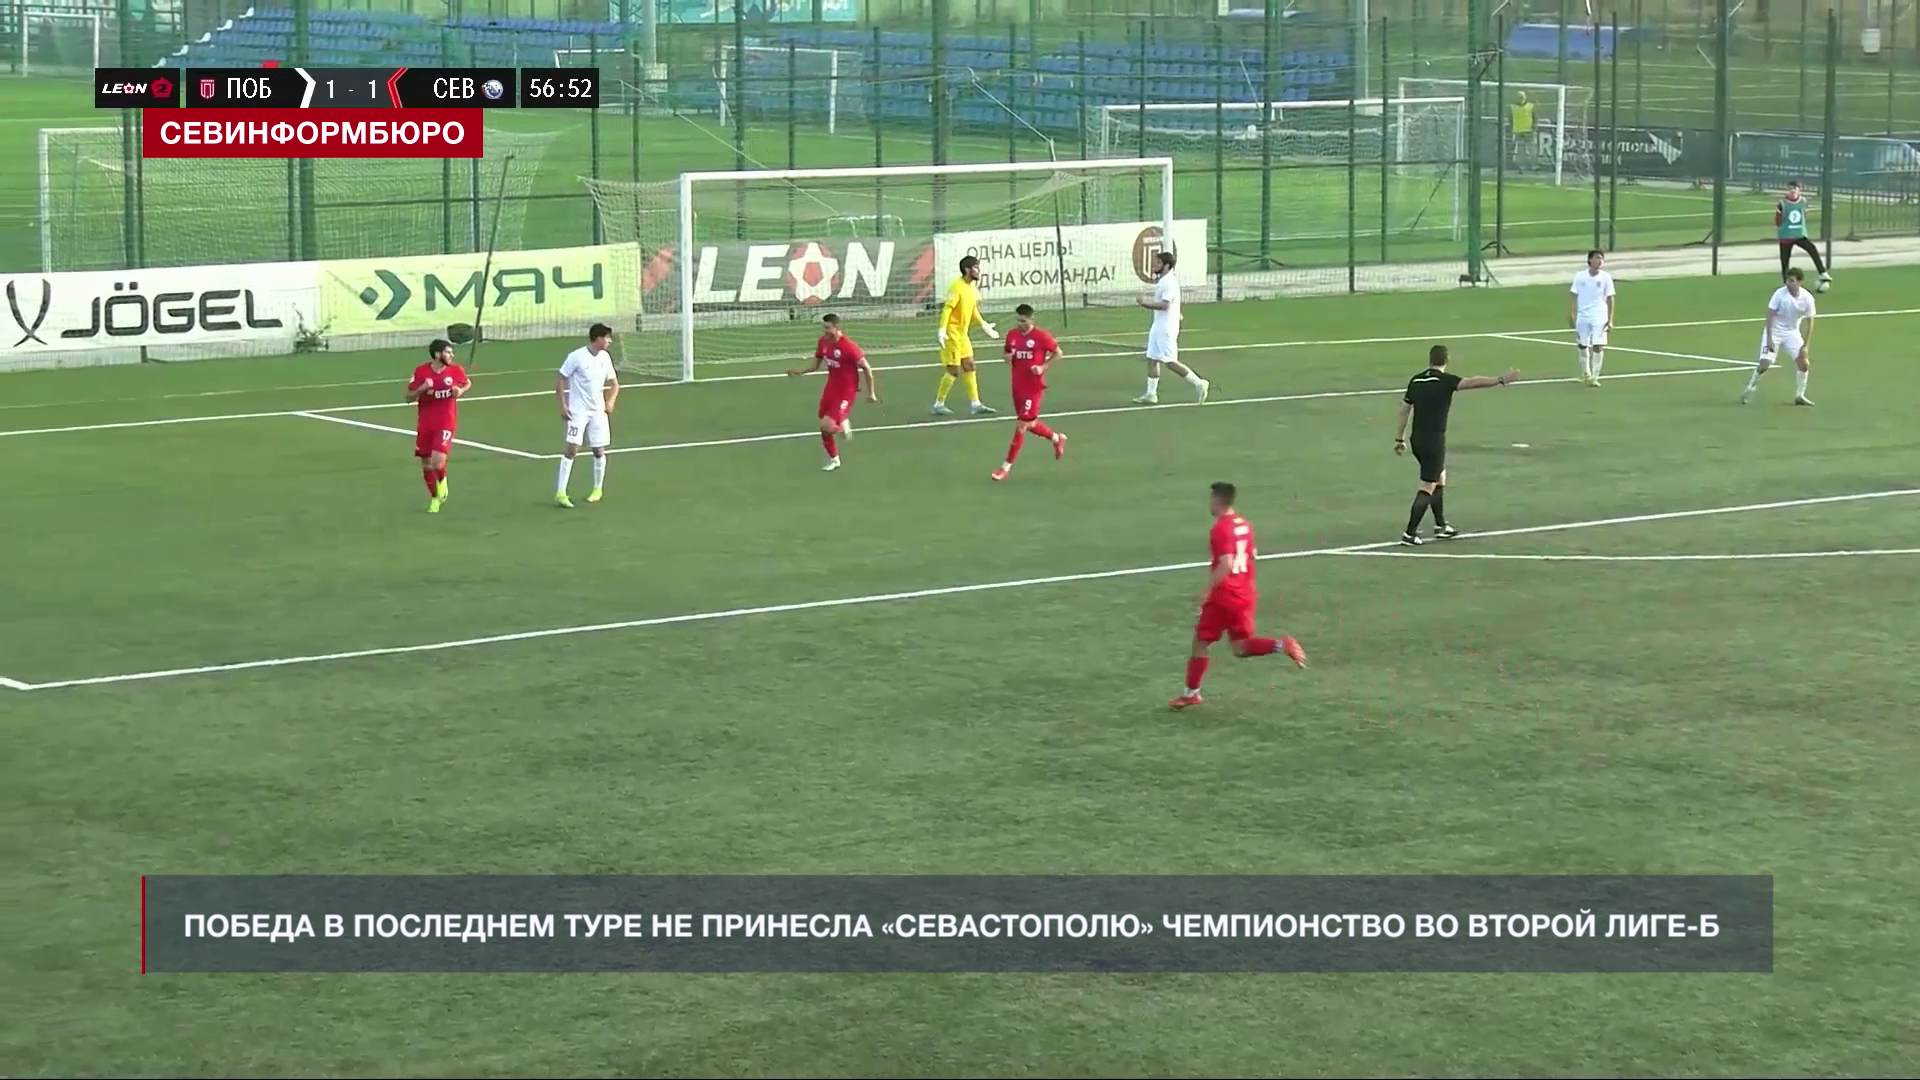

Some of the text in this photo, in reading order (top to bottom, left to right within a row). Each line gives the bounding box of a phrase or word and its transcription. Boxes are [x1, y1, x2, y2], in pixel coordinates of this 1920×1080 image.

[966, 240, 1073, 263] ОДНА ЦЕЛЬ!
[692, 241, 895, 304] LEON
[977, 266, 1116, 292] ДНА КОМАНДА!
[424, 263, 603, 311] МЯЧ
[61, 281, 283, 339] JÖGEL
[1025, 399, 1032, 410] 9
[568, 425, 579, 437] 20
